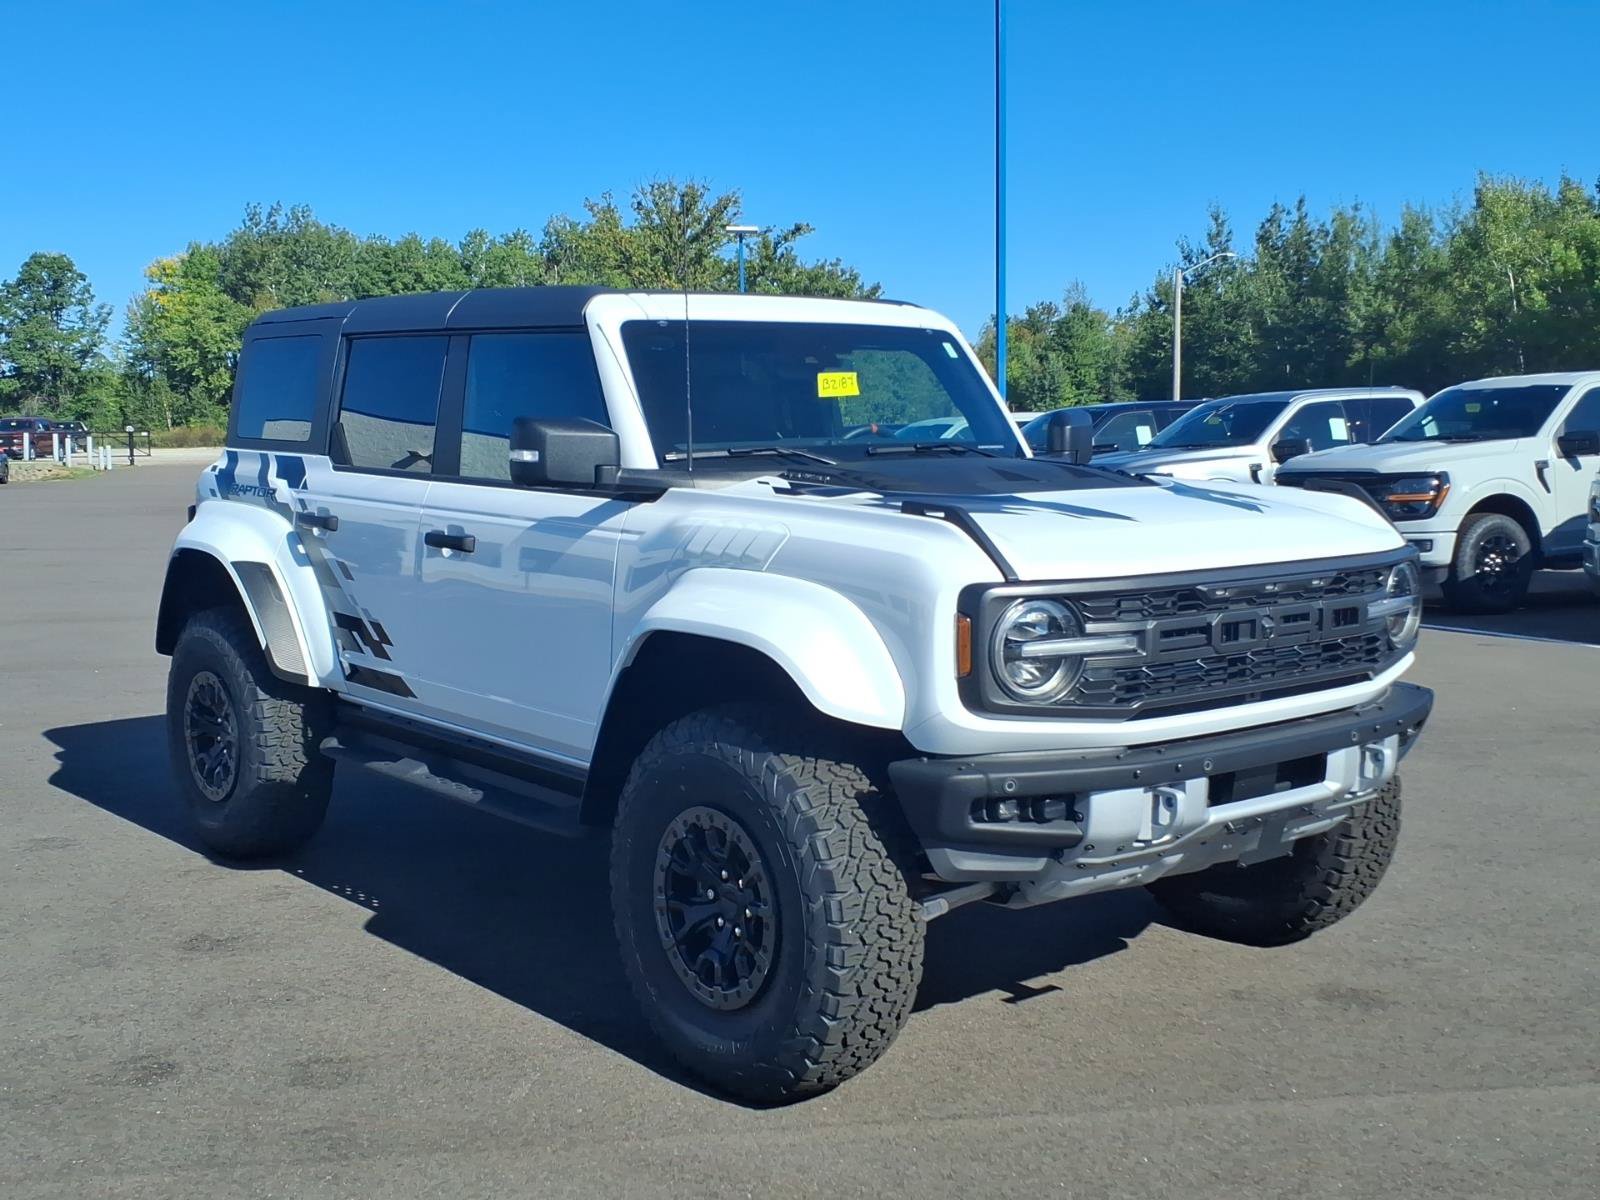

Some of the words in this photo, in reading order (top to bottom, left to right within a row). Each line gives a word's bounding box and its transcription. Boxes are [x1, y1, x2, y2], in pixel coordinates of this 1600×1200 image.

[822, 376, 854, 391] B2187
[229, 483, 278, 505] RAPTOR
[1145, 600, 1368, 665] FORD
